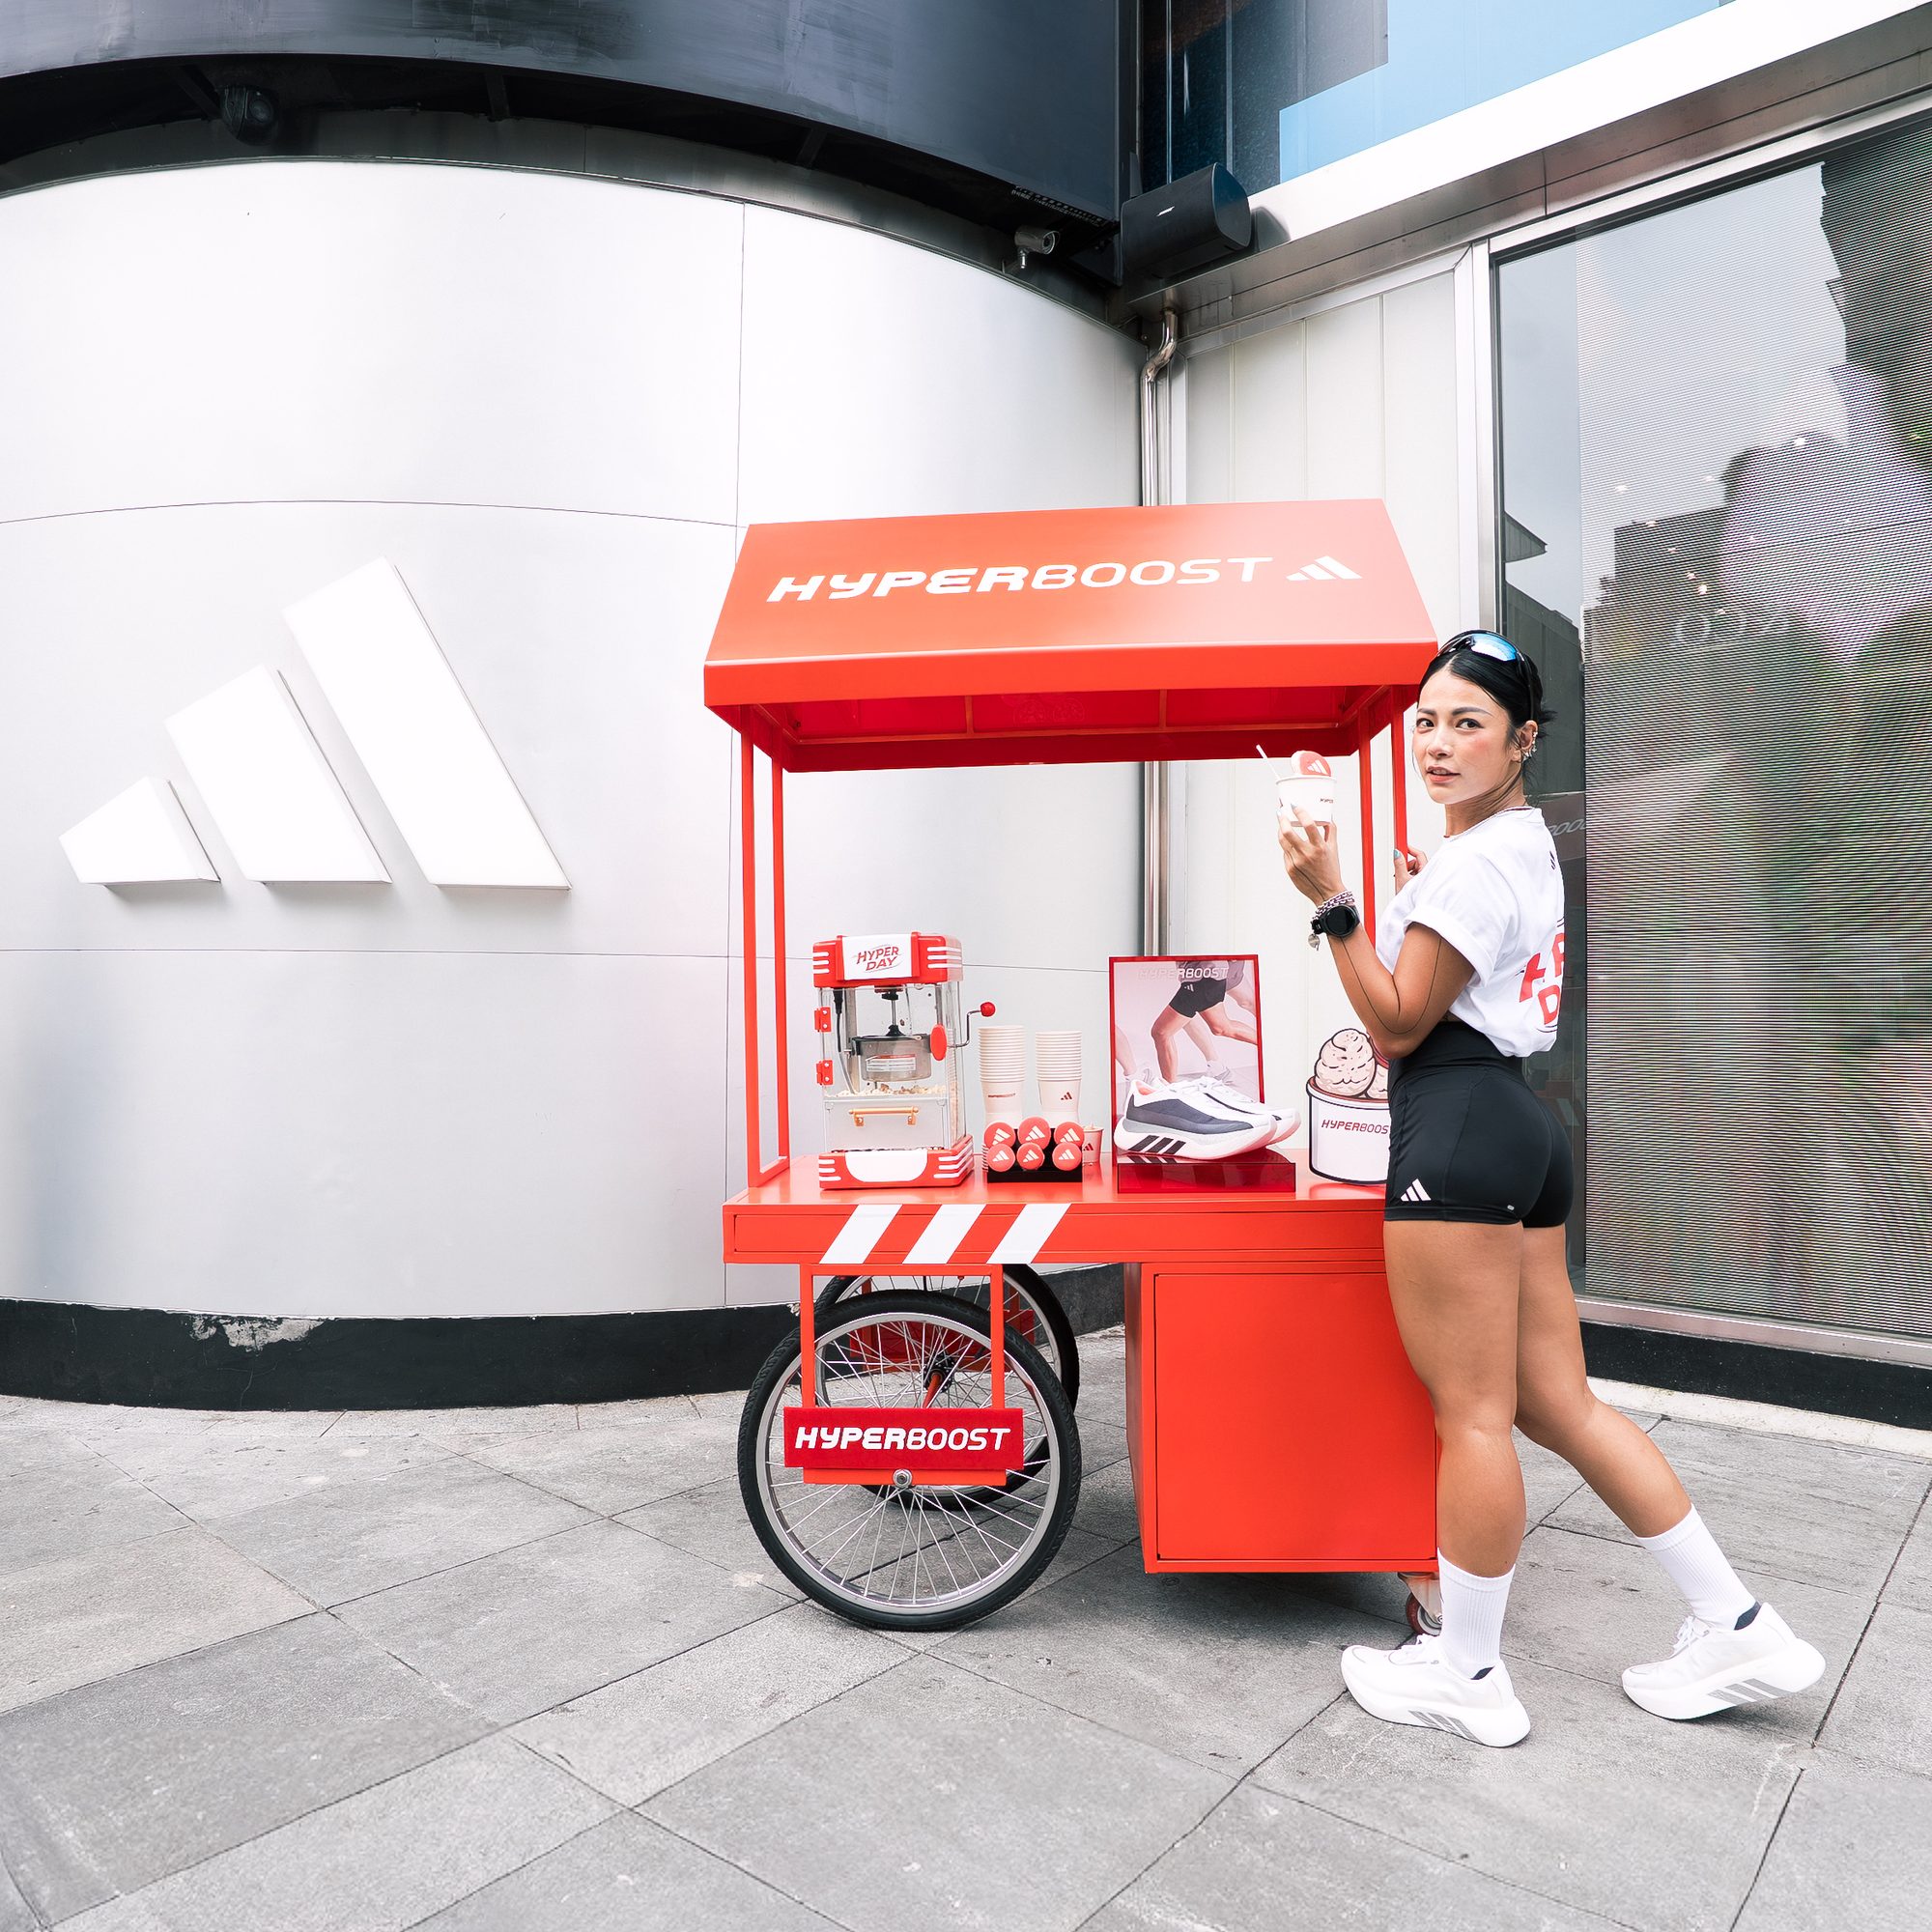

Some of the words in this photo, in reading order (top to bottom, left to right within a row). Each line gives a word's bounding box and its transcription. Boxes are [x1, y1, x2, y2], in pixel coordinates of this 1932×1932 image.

[766, 556, 1273, 602] HYPERBOOST
[856, 946, 899, 965] HYPER
[866, 955, 897, 971] DAY
[1321, 1119, 1390, 1135] HYPERBOOS
[794, 1426, 1011, 1451] HYPERBOOST
